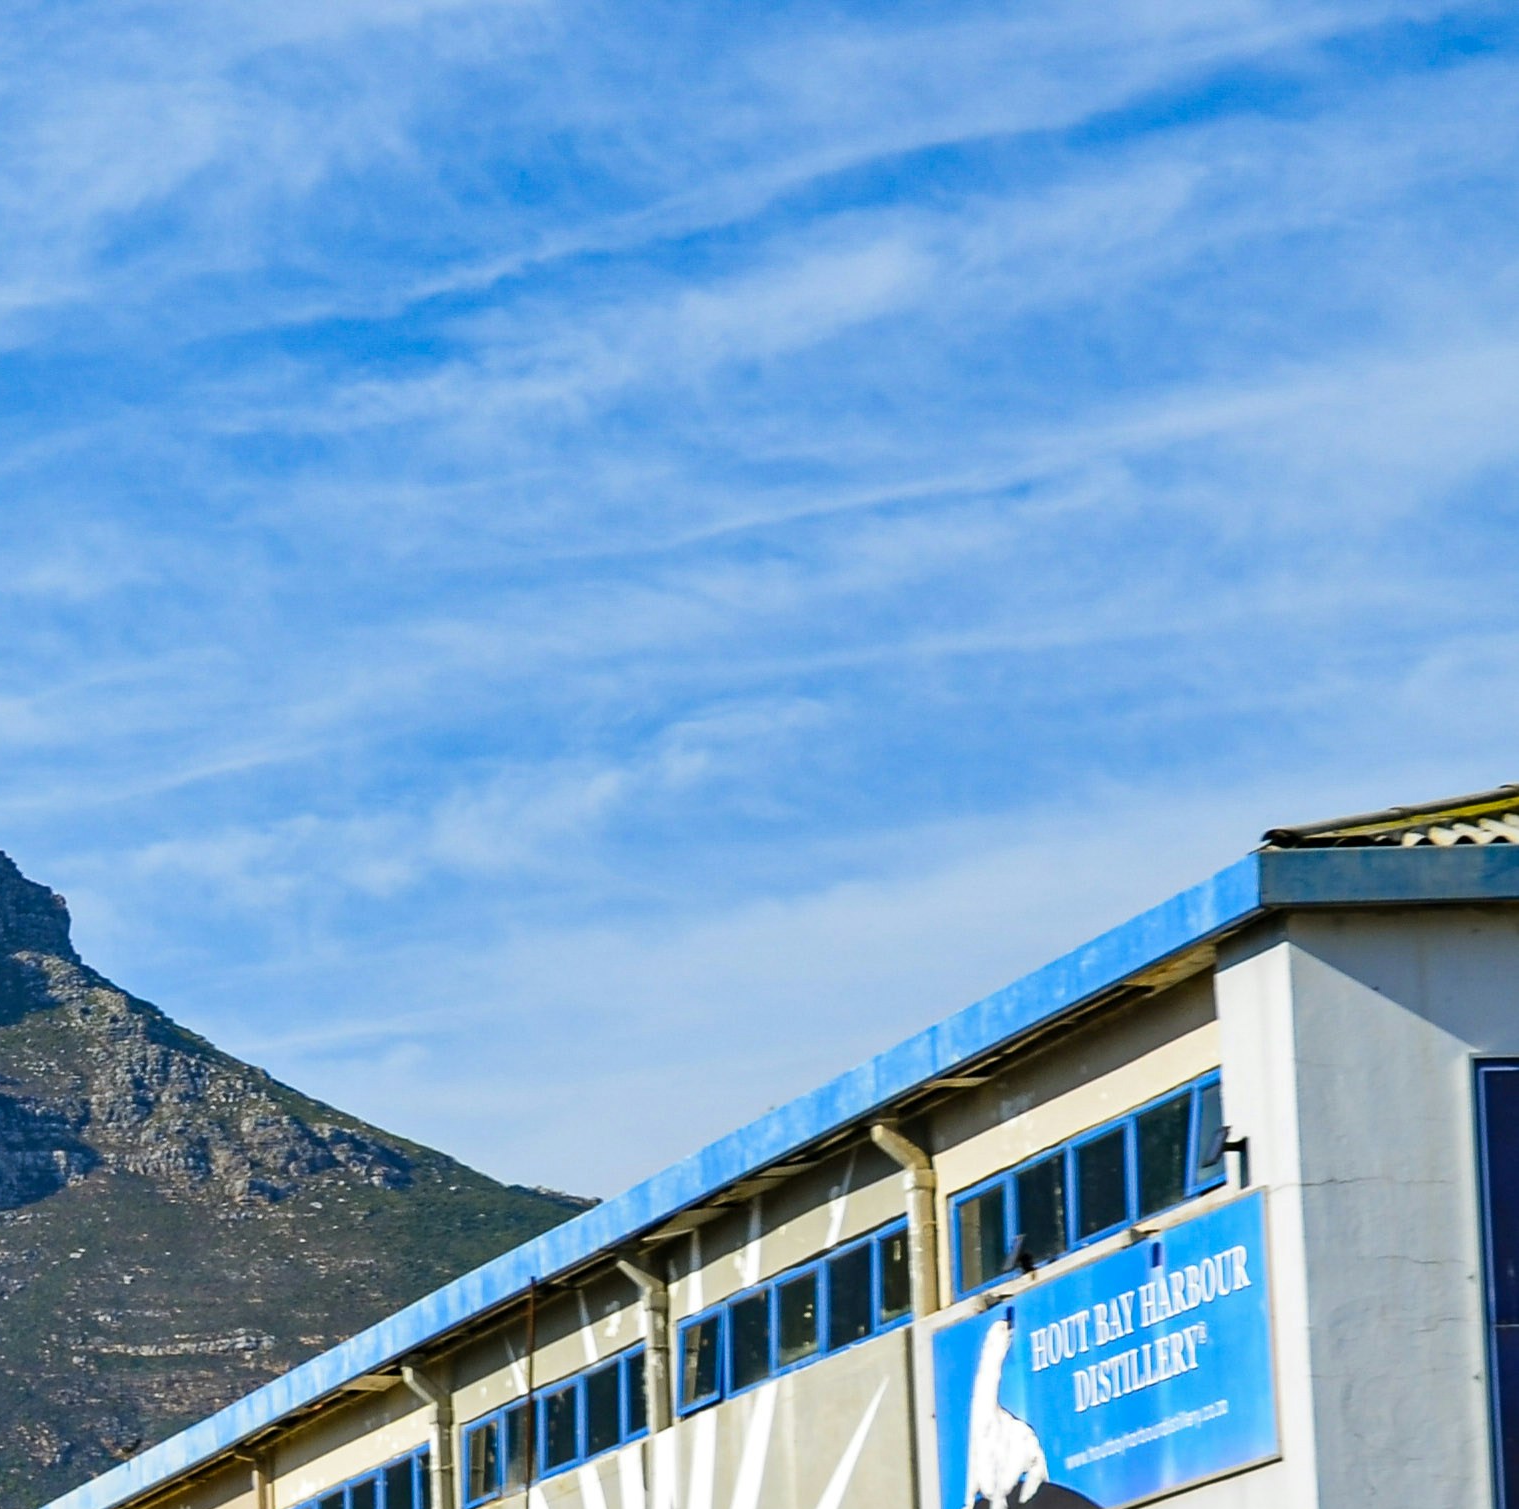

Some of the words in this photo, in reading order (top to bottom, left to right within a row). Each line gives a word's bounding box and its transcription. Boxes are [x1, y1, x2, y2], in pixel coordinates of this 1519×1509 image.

[1030, 1310, 1090, 1372] HOUT
[1093, 1291, 1135, 1346] BAY
[1138, 1245, 1252, 1328] HARBOUR
[1072, 1326, 1200, 1413] DISTILLERY
